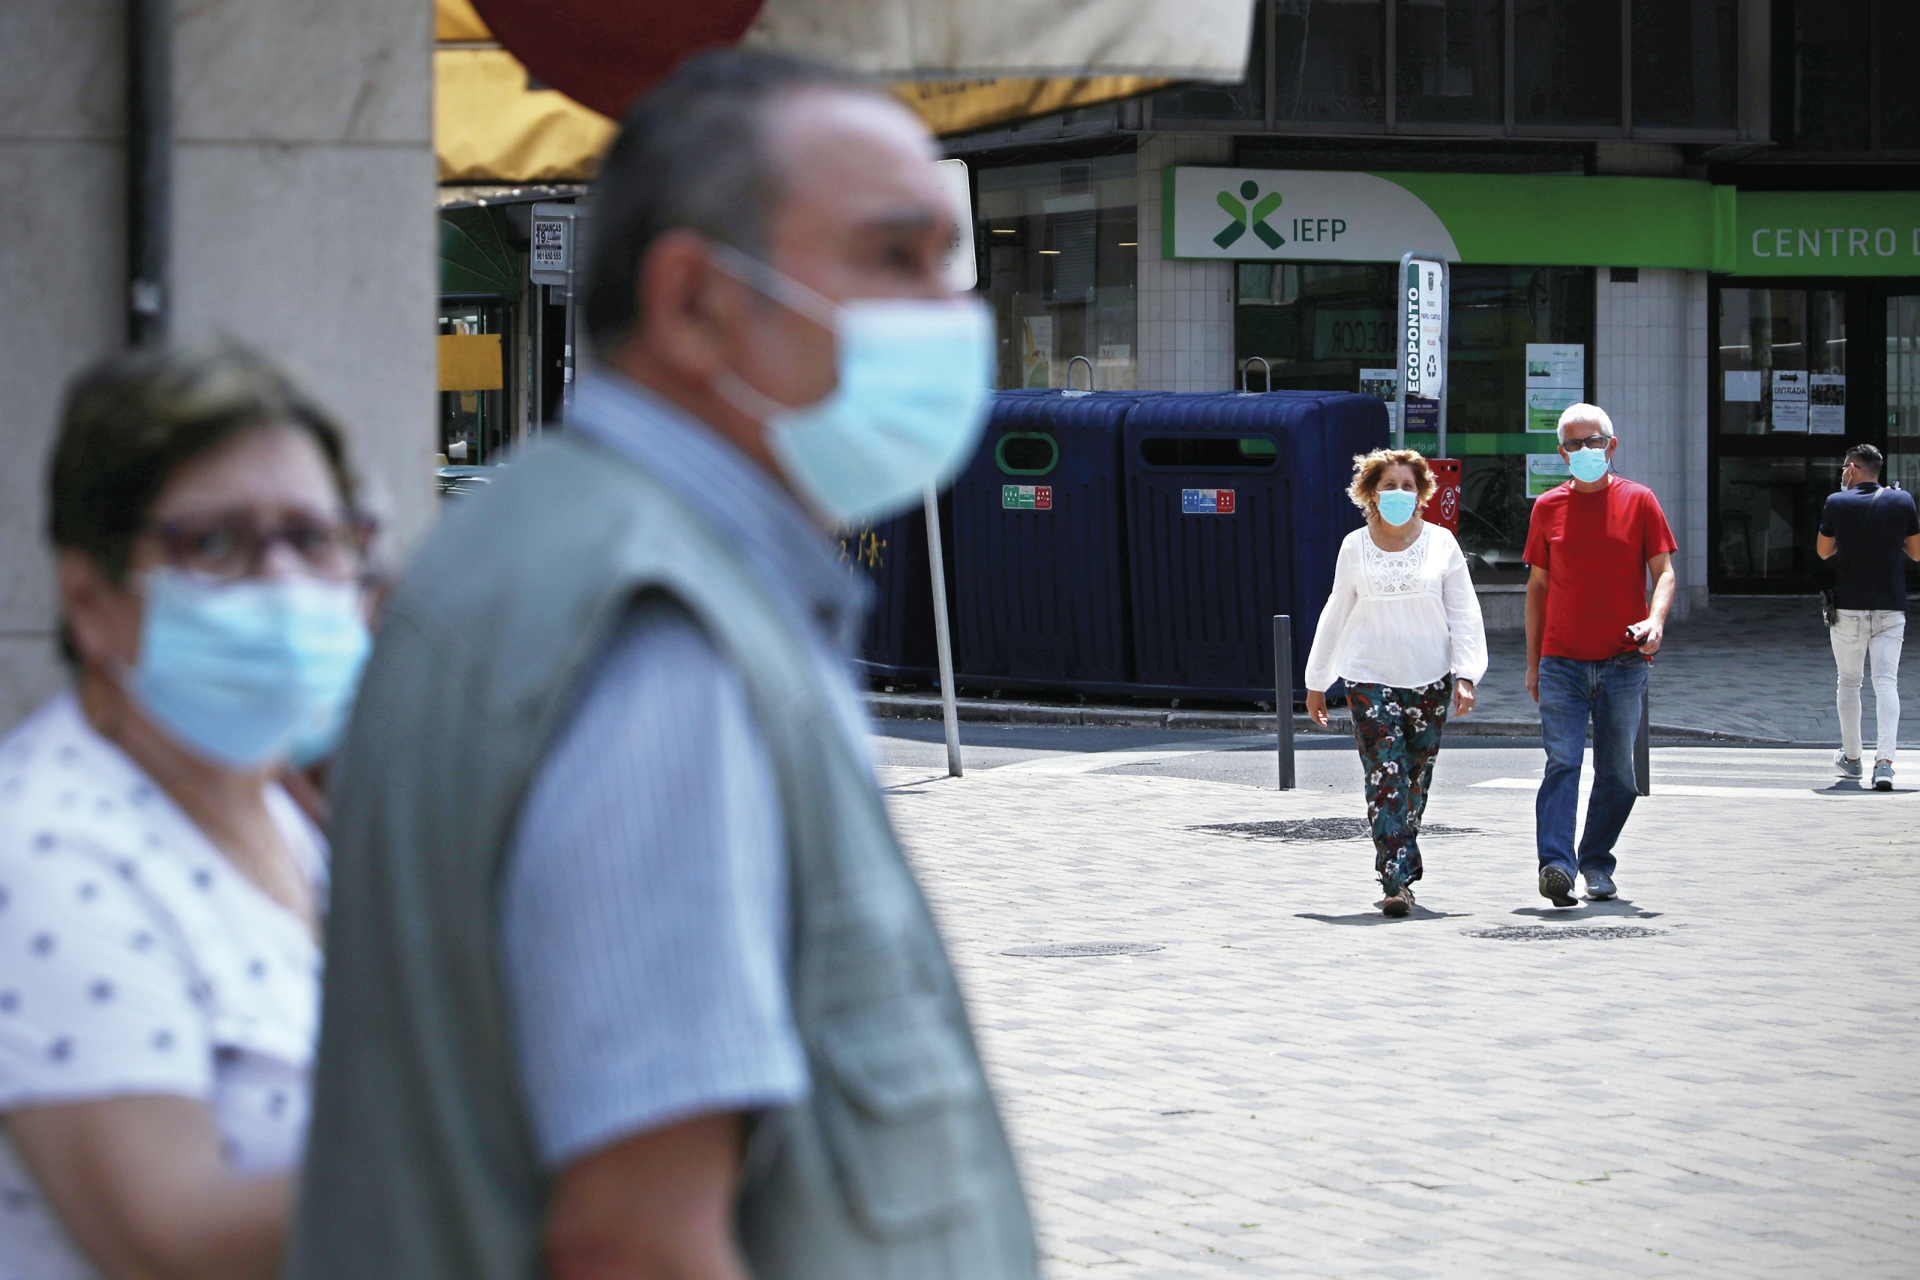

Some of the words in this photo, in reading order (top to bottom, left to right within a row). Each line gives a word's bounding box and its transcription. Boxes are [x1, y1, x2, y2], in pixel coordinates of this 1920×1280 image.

[1293, 218, 1347, 242] IEFP
[1752, 227, 1897, 257] CENTRO
[1407, 287, 1419, 392] ECOPONTO
[1774, 387, 1807, 395] ENTRADA
